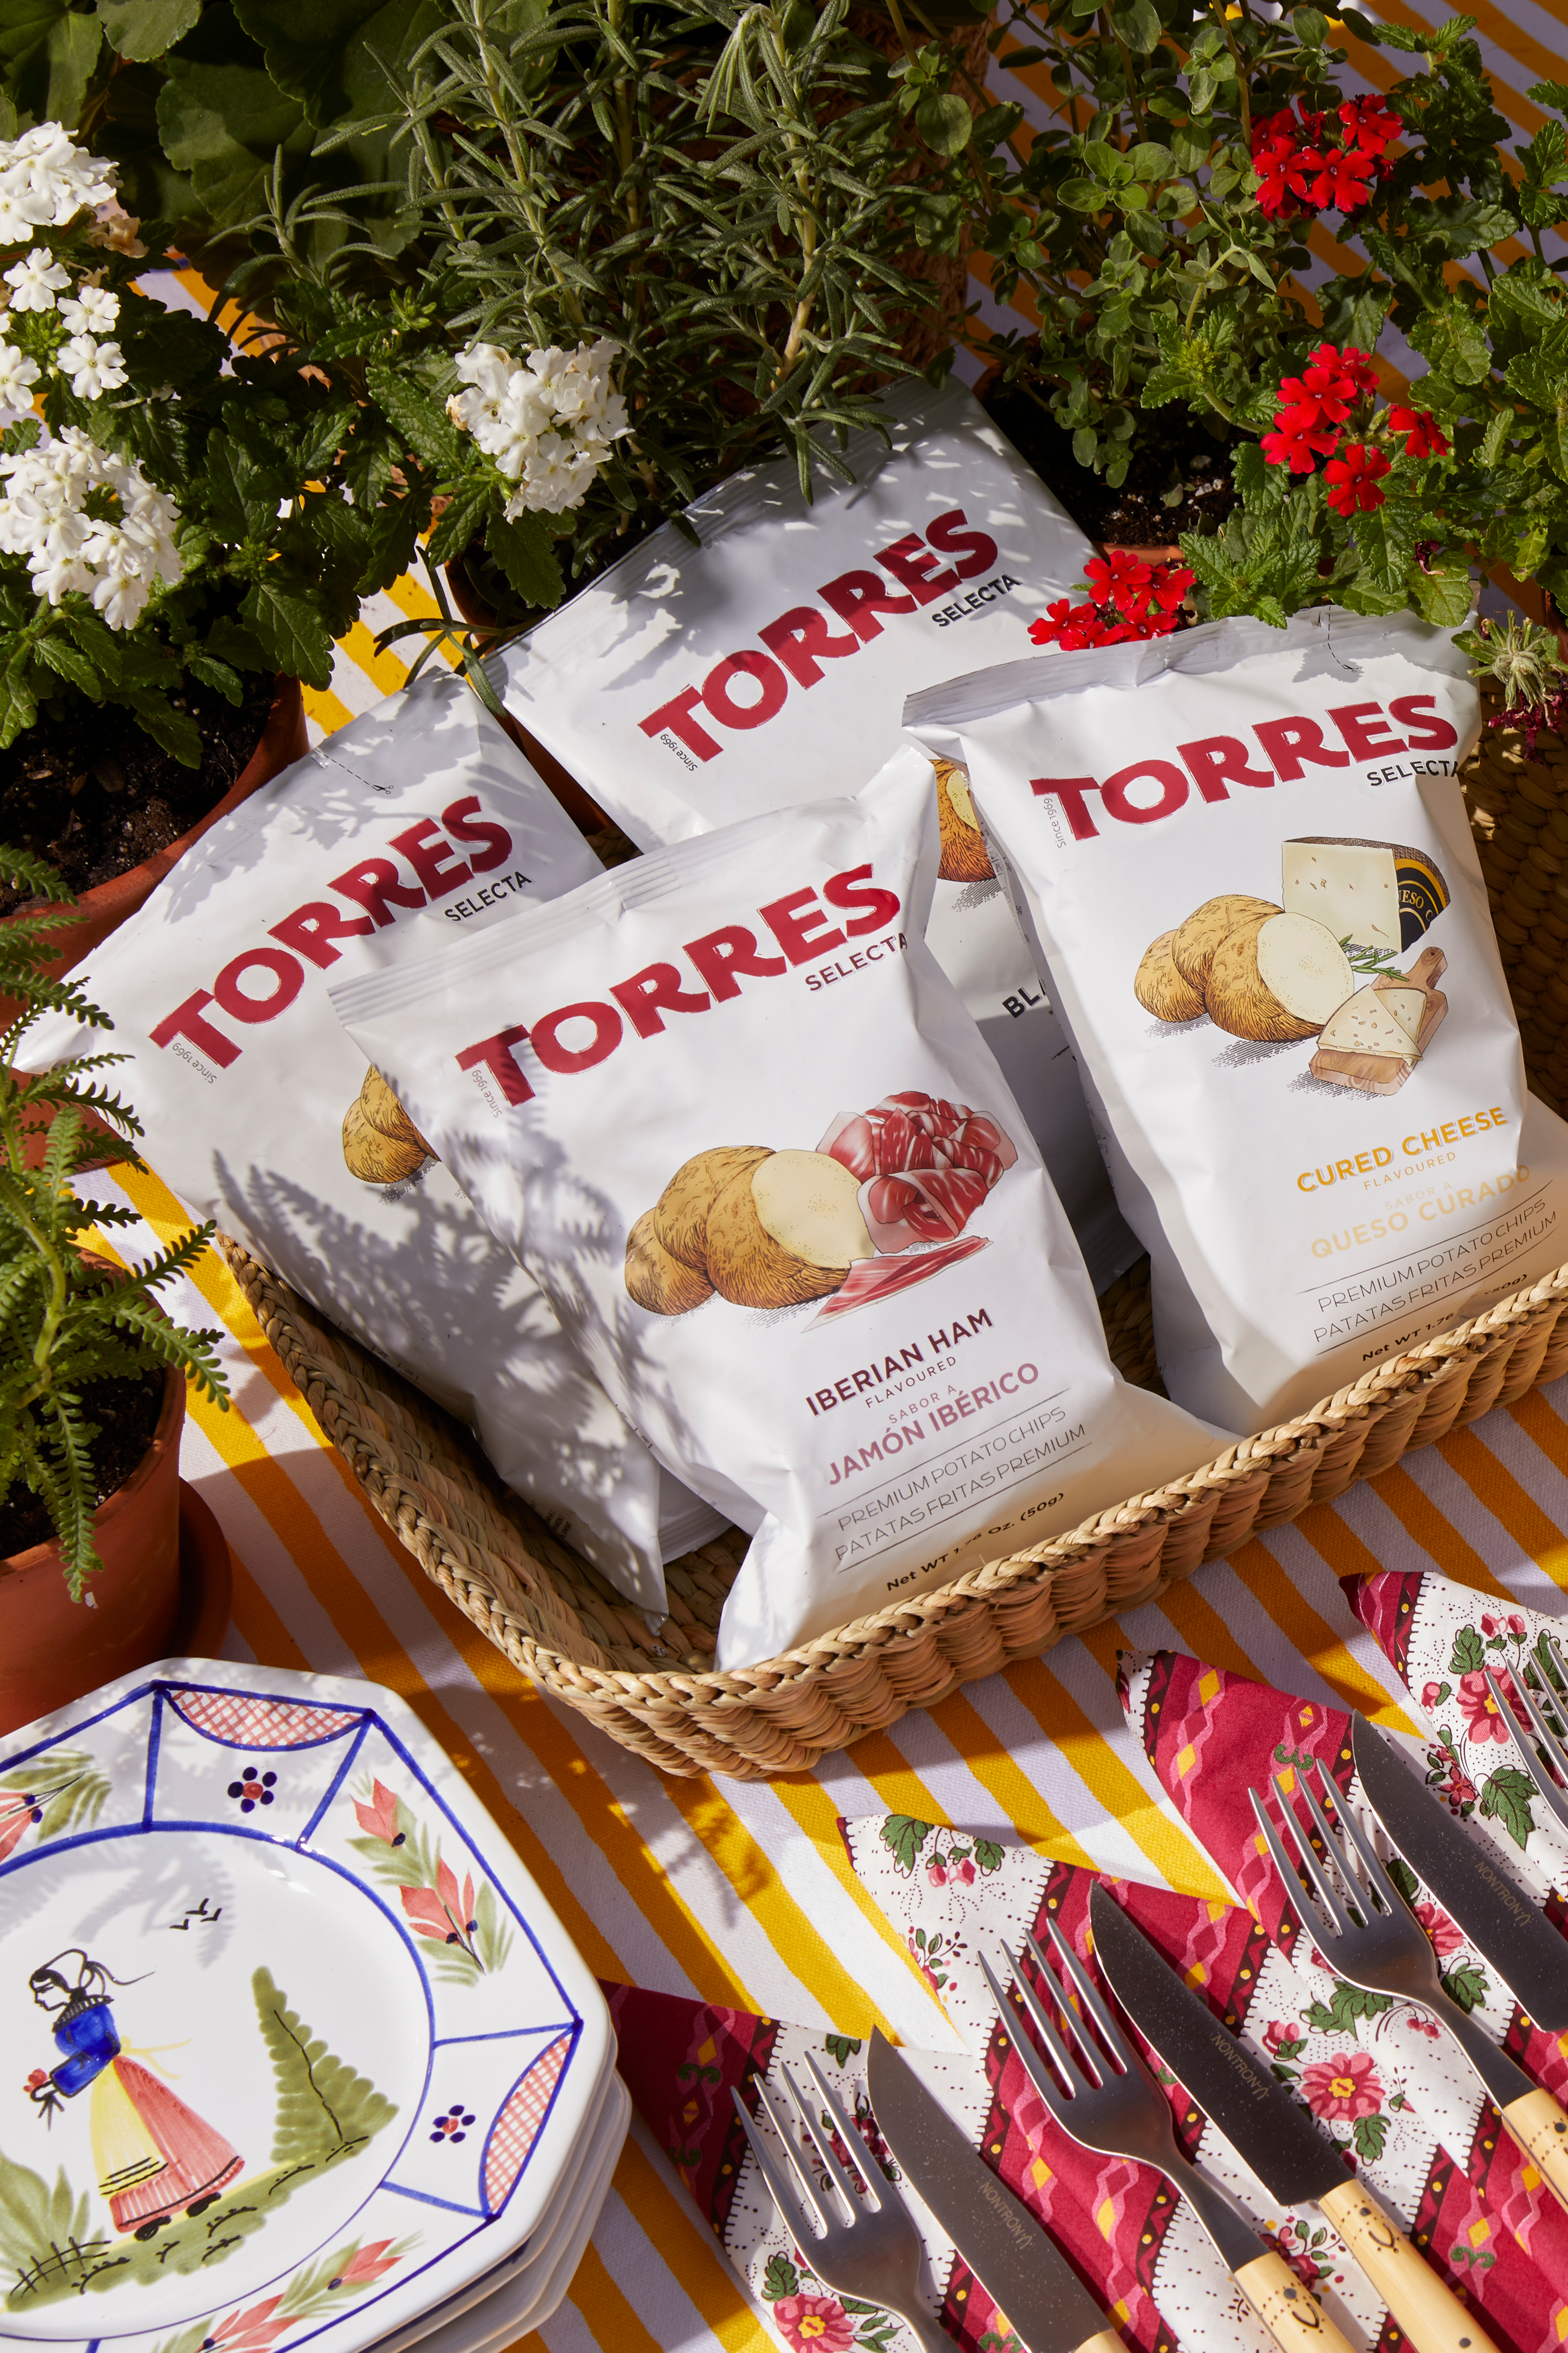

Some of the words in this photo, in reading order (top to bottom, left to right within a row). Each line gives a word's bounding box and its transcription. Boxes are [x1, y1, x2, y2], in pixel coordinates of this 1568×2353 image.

[932, 574, 1022, 627] SELECTA
[638, 509, 998, 762] TORRES
[660, 734, 678, 752] 1969
[676, 750, 698, 771] Since
[1029, 695, 1458, 842] TORRES
[1044, 798, 1056, 820] 1969
[1052, 821, 1066, 848] Since
[445, 871, 532, 923] SELECTA
[148, 795, 513, 1069] TORRES
[455, 862, 900, 1108] TORRES
[805, 933, 908, 991] SELECTA
[1002, 978, 1046, 1019] BL
[172, 1043, 192, 1063] 1969
[192, 1060, 217, 1083] Since
[472, 1070, 487, 1092] 1969
[483, 1091, 503, 1118] Since
[1297, 1146, 1393, 1192] CURED
[1402, 1107, 1509, 1156] CHEESE
[1363, 1152, 1456, 1190] FLAVOURED
[1311, 1211, 1408, 1258] QUESO
[1419, 1165, 1530, 1221] CURADO
[1385, 1186, 1435, 1210] SABOR
[1314, 1296, 1406, 1342] PATATAS
[1409, 1263, 1477, 1303] FRITAS
[1479, 1210, 1556, 1269] PREMIUM
[1318, 1266, 1414, 1312] PREMIUM
[1417, 1232, 1493, 1274] POTATO
[1495, 1199, 1545, 1237] CHIPS
[806, 1343, 924, 1416] IBERIAN
[928, 1308, 994, 1354] HAM
[1363, 1344, 1389, 1361] Net
[1395, 1329, 1421, 1345] WT
[865, 1356, 956, 1408] FLAVOURED
[889, 1392, 940, 1424] SABOR
[947, 1384, 957, 1394] A
[829, 1420, 926, 1486] JAMÓN
[929, 1363, 1039, 1432] IBÉRICO
[835, 1508, 925, 1560] PATATAS
[928, 1472, 996, 1516] FRITAS
[997, 1424, 1085, 1479] PREMIUM
[838, 1476, 930, 1531] PREMIUM
[931, 1436, 1007, 1483] POTATO
[1009, 1406, 1066, 1444] CHIPS
[887, 1571, 917, 1591] Net
[921, 1553, 948, 1573] WT
[1020, 1493, 1064, 1521] (50g)
[1475, 1861, 1523, 1914] NONTRON
[1212, 2034, 1261, 2087] NONTRON
[980, 2181, 1025, 2236] NONTRON
